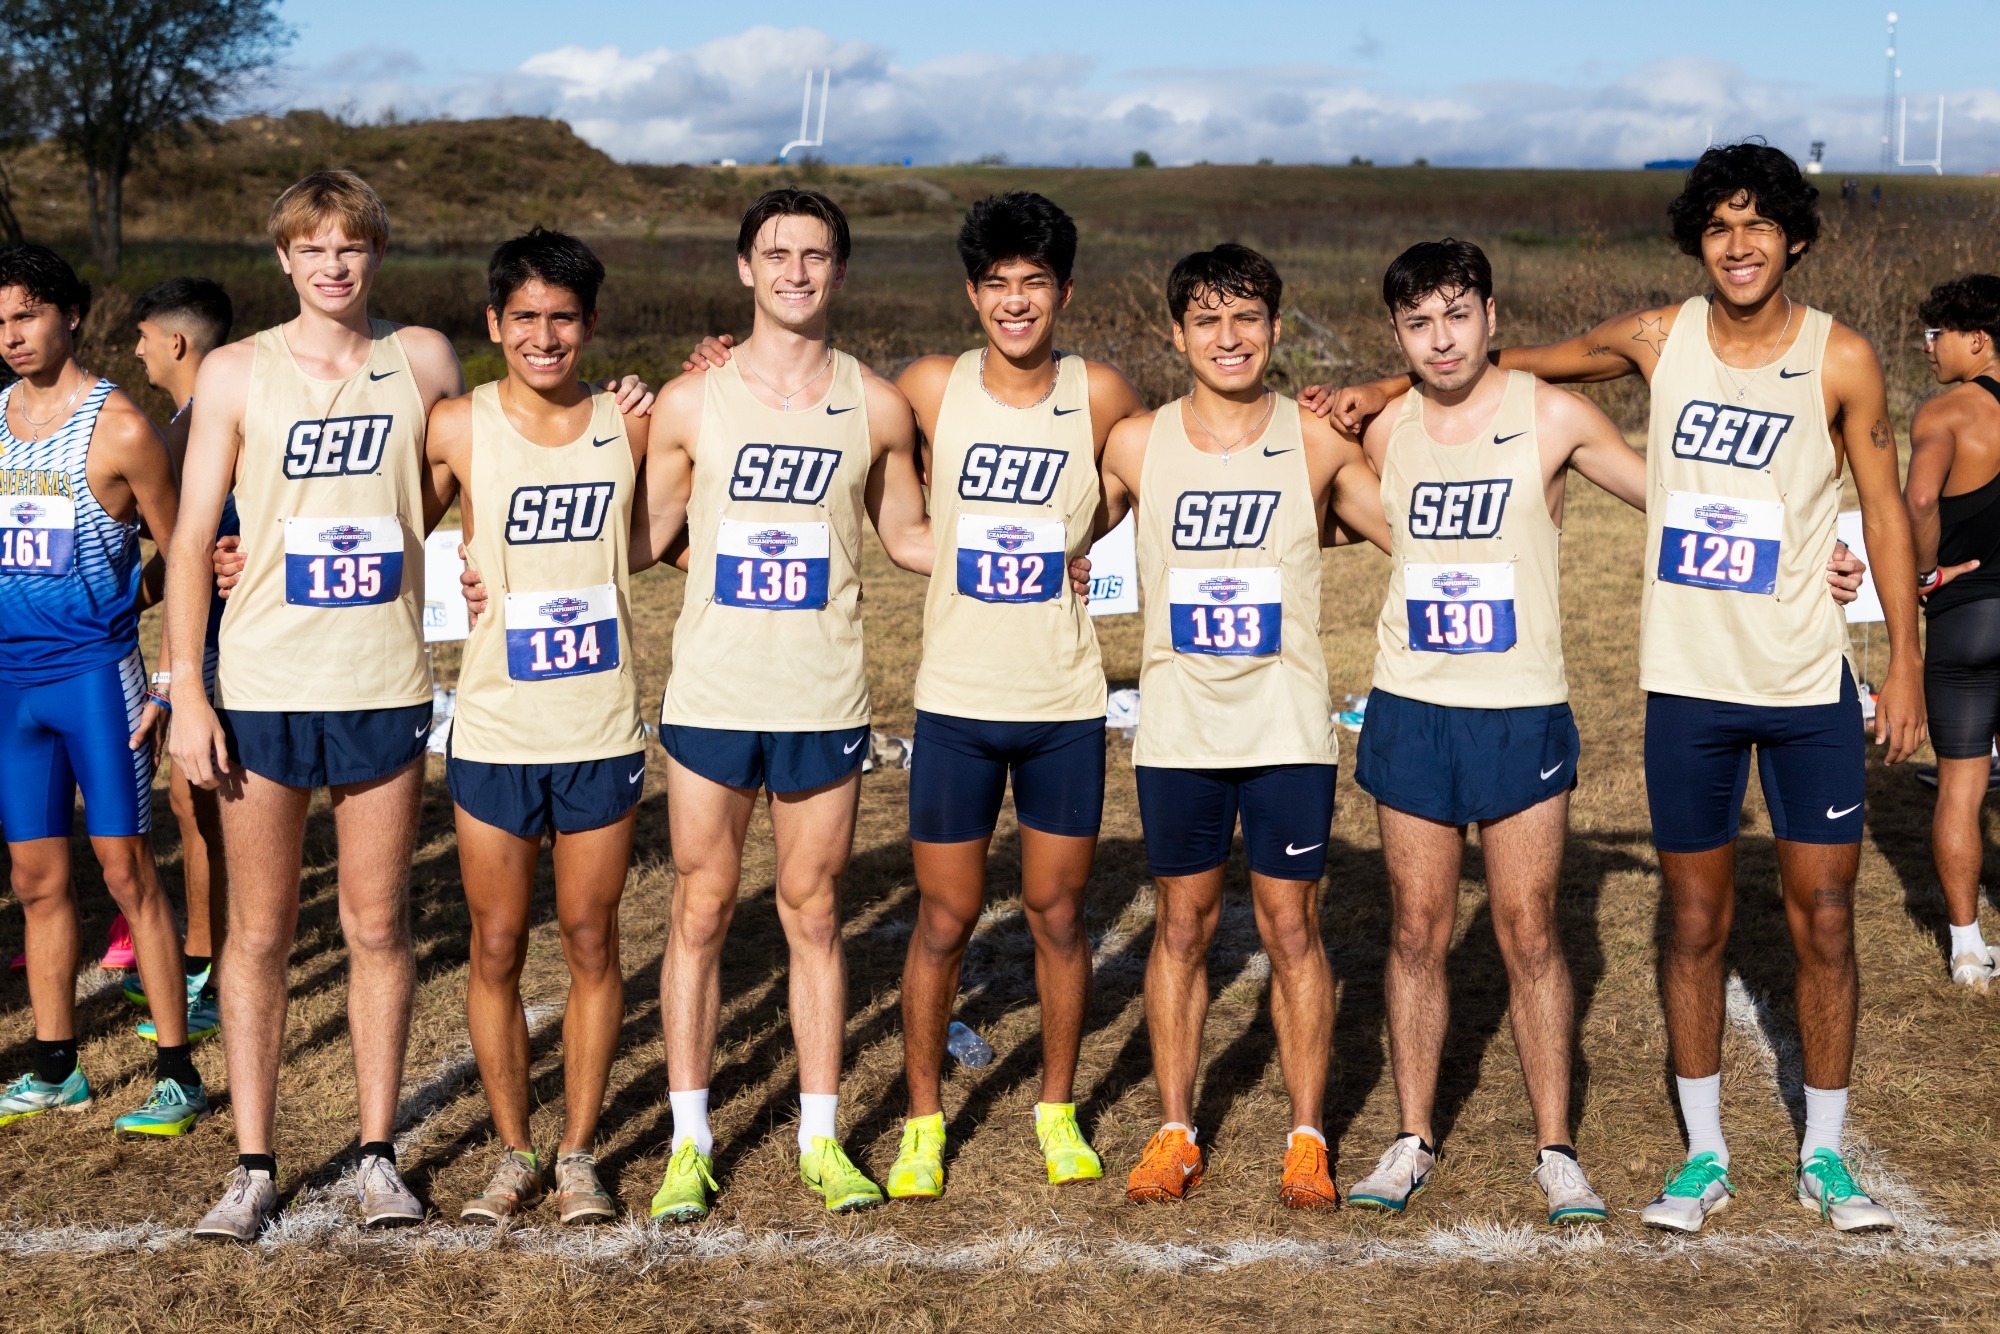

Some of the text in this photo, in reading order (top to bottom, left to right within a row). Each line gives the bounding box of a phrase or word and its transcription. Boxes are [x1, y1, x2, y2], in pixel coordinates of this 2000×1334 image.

[283, 415, 393, 480] SEU
[1672, 400, 1794, 470] SEU
[729, 444, 842, 505] SEU
[958, 444, 1069, 505] SEU
[505, 482, 615, 545] SEU
[1172, 491, 1281, 550] SEU
[1409, 479, 1512, 540] SEU
[1, 529, 52, 567] 161
[1677, 533, 1756, 583] 129
[308, 556, 382, 599] 135
[736, 559, 807, 602] 136
[976, 553, 1044, 596] 132
[529, 625, 601, 671] 134
[1192, 605, 1261, 648] 133
[1425, 602, 1494, 646] 130
